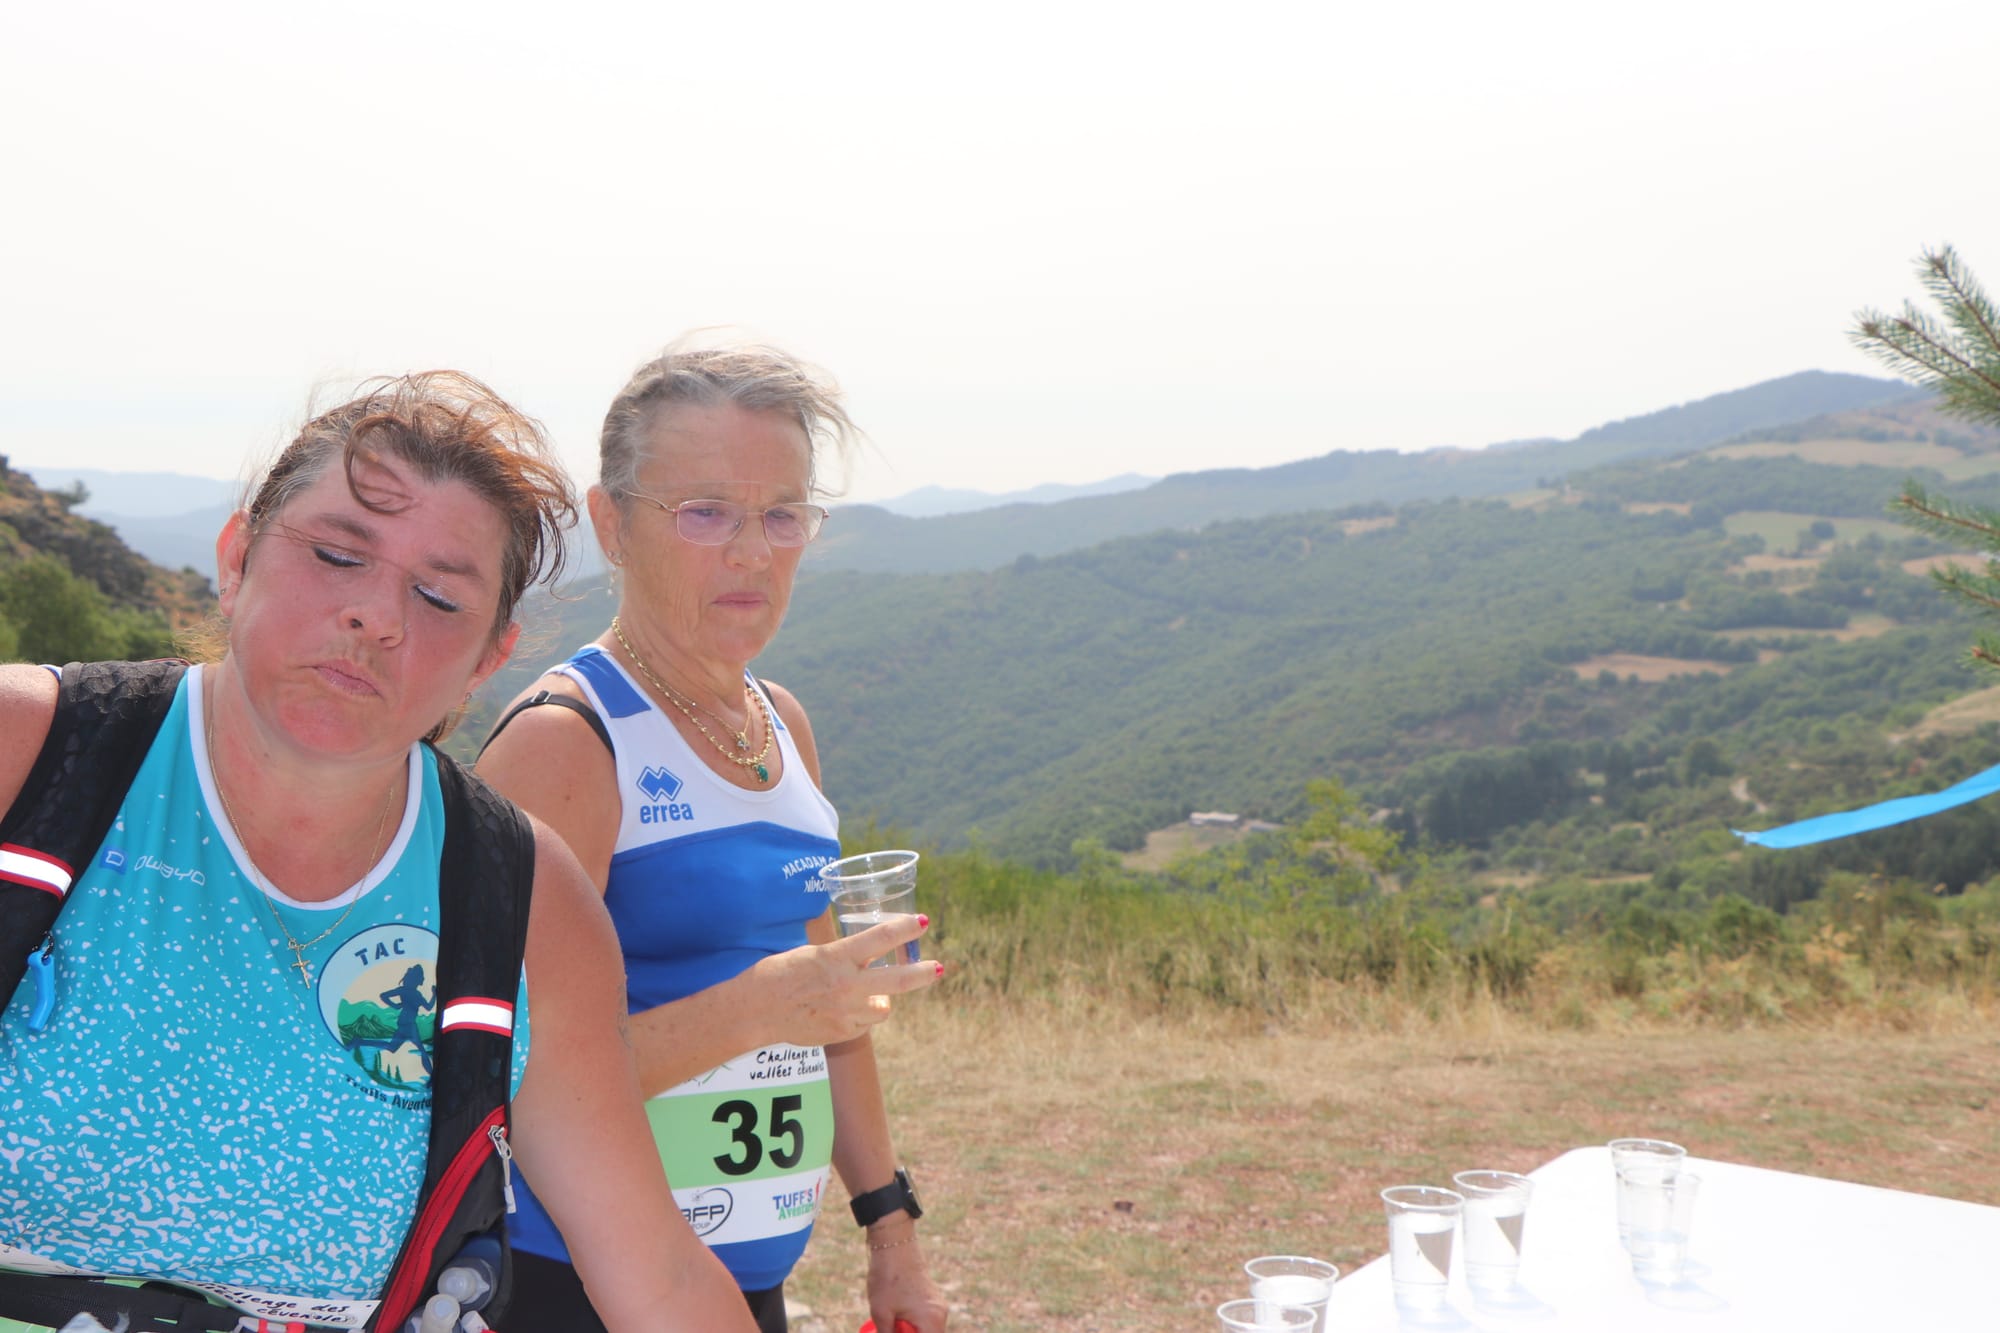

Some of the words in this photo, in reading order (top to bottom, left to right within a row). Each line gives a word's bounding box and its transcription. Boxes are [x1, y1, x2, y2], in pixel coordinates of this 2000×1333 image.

[354, 938, 406, 966] TAC
[756, 1048, 808, 1064] Challenge
[749, 1064, 792, 1080] vallées
[392, 1093, 432, 1111] Aventu
[711, 1094, 804, 1176] 35
[311, 1304, 350, 1313] des
